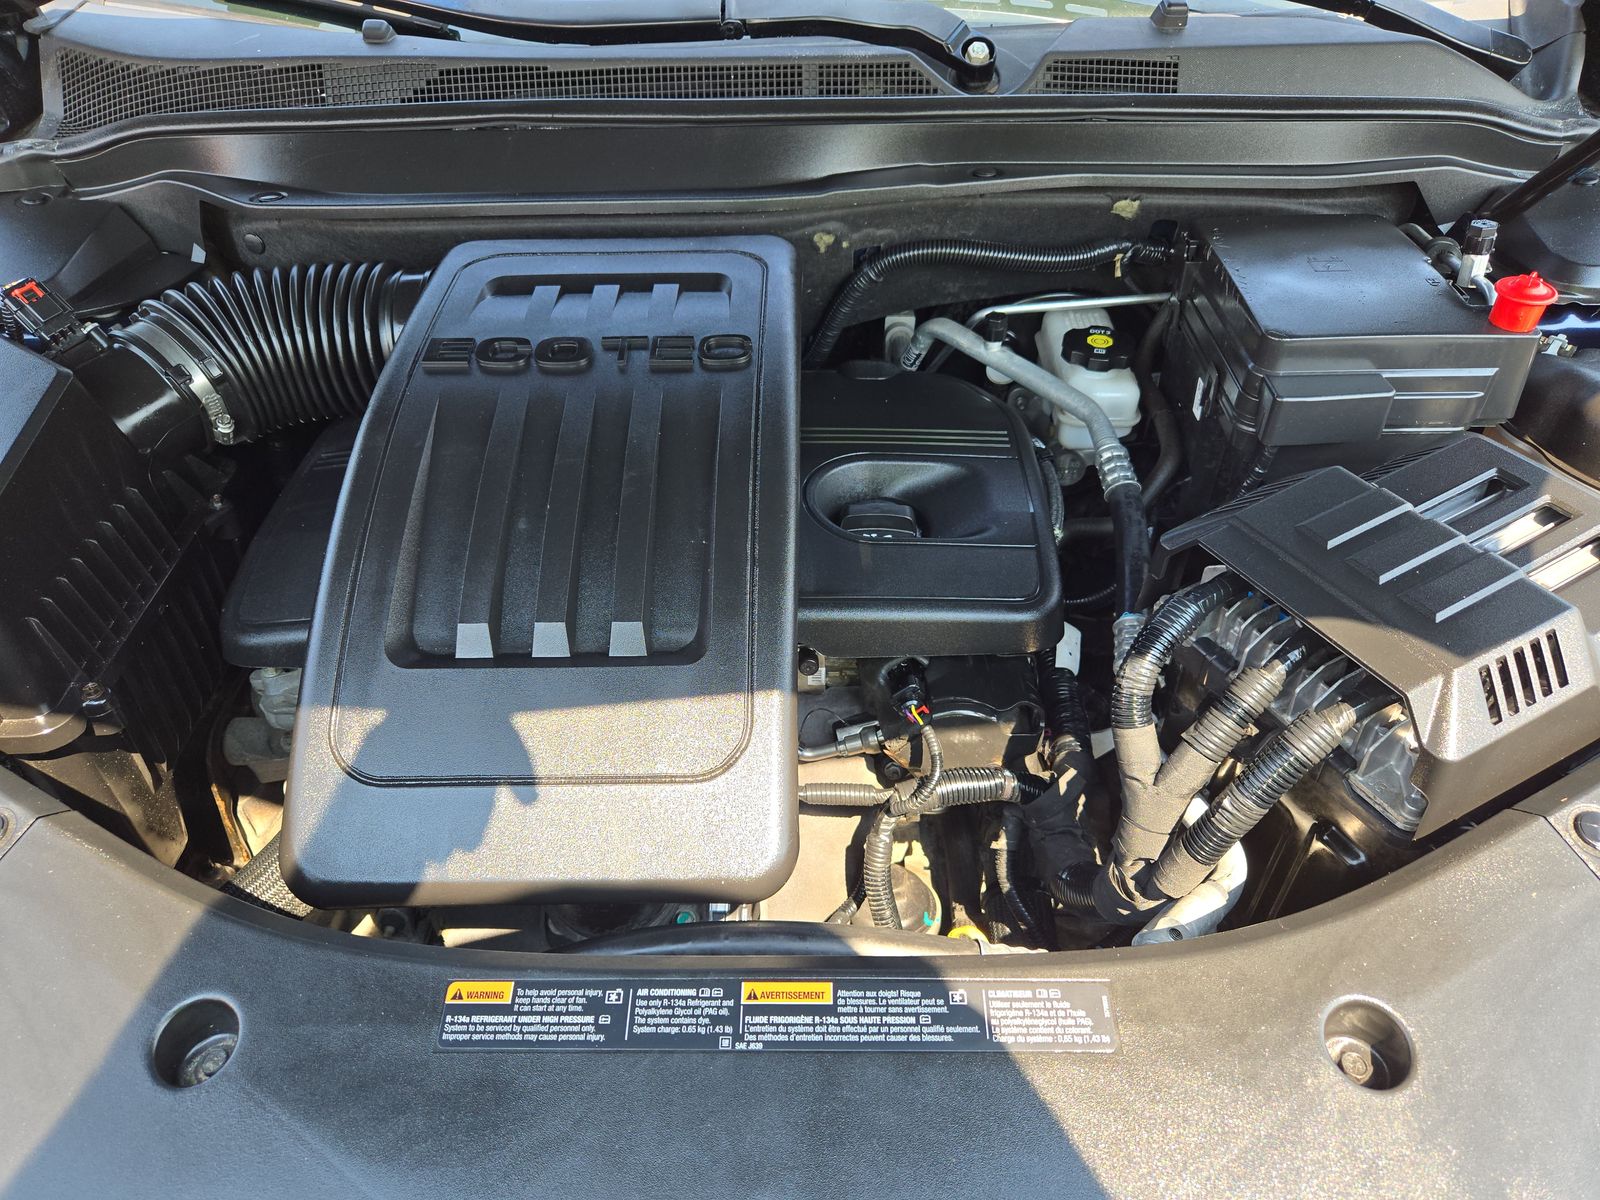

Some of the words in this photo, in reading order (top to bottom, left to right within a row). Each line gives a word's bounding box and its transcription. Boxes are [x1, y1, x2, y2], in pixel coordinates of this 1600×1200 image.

[421, 333, 753, 371] ECOTEC
[467, 991, 505, 1000] WARNING
[525, 988, 538, 997] help
[558, 988, 584, 998] personal
[636, 988, 649, 996] AIR
[650, 988, 697, 996] CONDITIONING
[760, 992, 826, 1000] AVERTISSEMENT
[900, 990, 922, 998] Risque
[514, 996, 530, 1005] keep
[648, 999, 662, 1008] only
[687, 998, 722, 1008] Refrigerant
[921, 998, 936, 1006] peut
[634, 1008, 673, 1016] Polyalkylene
[674, 1008, 693, 1016] Glycol
[702, 1008, 718, 1016] (PAG
[446, 1015, 470, 1023] R-134a
[471, 1015, 518, 1023] REFRIGERANT
[560, 1016, 595, 1024] PRESSURE
[646, 1017, 670, 1025] system
[698, 1016, 711, 1026] dye.
[744, 1016, 769, 1024] FLUIDE
[770, 1014, 814, 1024] FRIGORIGÈNE
[814, 1016, 839, 1024] R-134a
[840, 1016, 858, 1024] SOUS
[859, 1016, 882, 1024] HAUTE
[882, 1016, 916, 1024] PRESSION
[444, 1024, 468, 1032] System
[512, 1024, 522, 1032] by
[522, 1024, 550, 1032] qualified
[550, 1024, 580, 1032] personnel
[581, 1024, 596, 1032] only.
[632, 1026, 656, 1034] System
[657, 1026, 681, 1034] charge:
[698, 1026, 706, 1034] kg
[706, 1026, 724, 1034] (1.43
[724, 1026, 733, 1034] lb)
[778, 1024, 787, 1032] du
[788, 1025, 814, 1034] système
[814, 1024, 828, 1032] doit
[868, 1026, 880, 1034] par
[890, 1025, 921, 1034] personnel
[922, 1025, 945, 1034] qualifié
[946, 1025, 980, 1033] seulement.
[442, 1032, 471, 1041] Improper
[558, 1033, 586, 1042] personal
[758, 1033, 788, 1041] méthodes
[824, 1034, 860, 1042] incorrectes
[860, 1034, 886, 1042] peuvent
[734, 1042, 748, 1050] SAE
